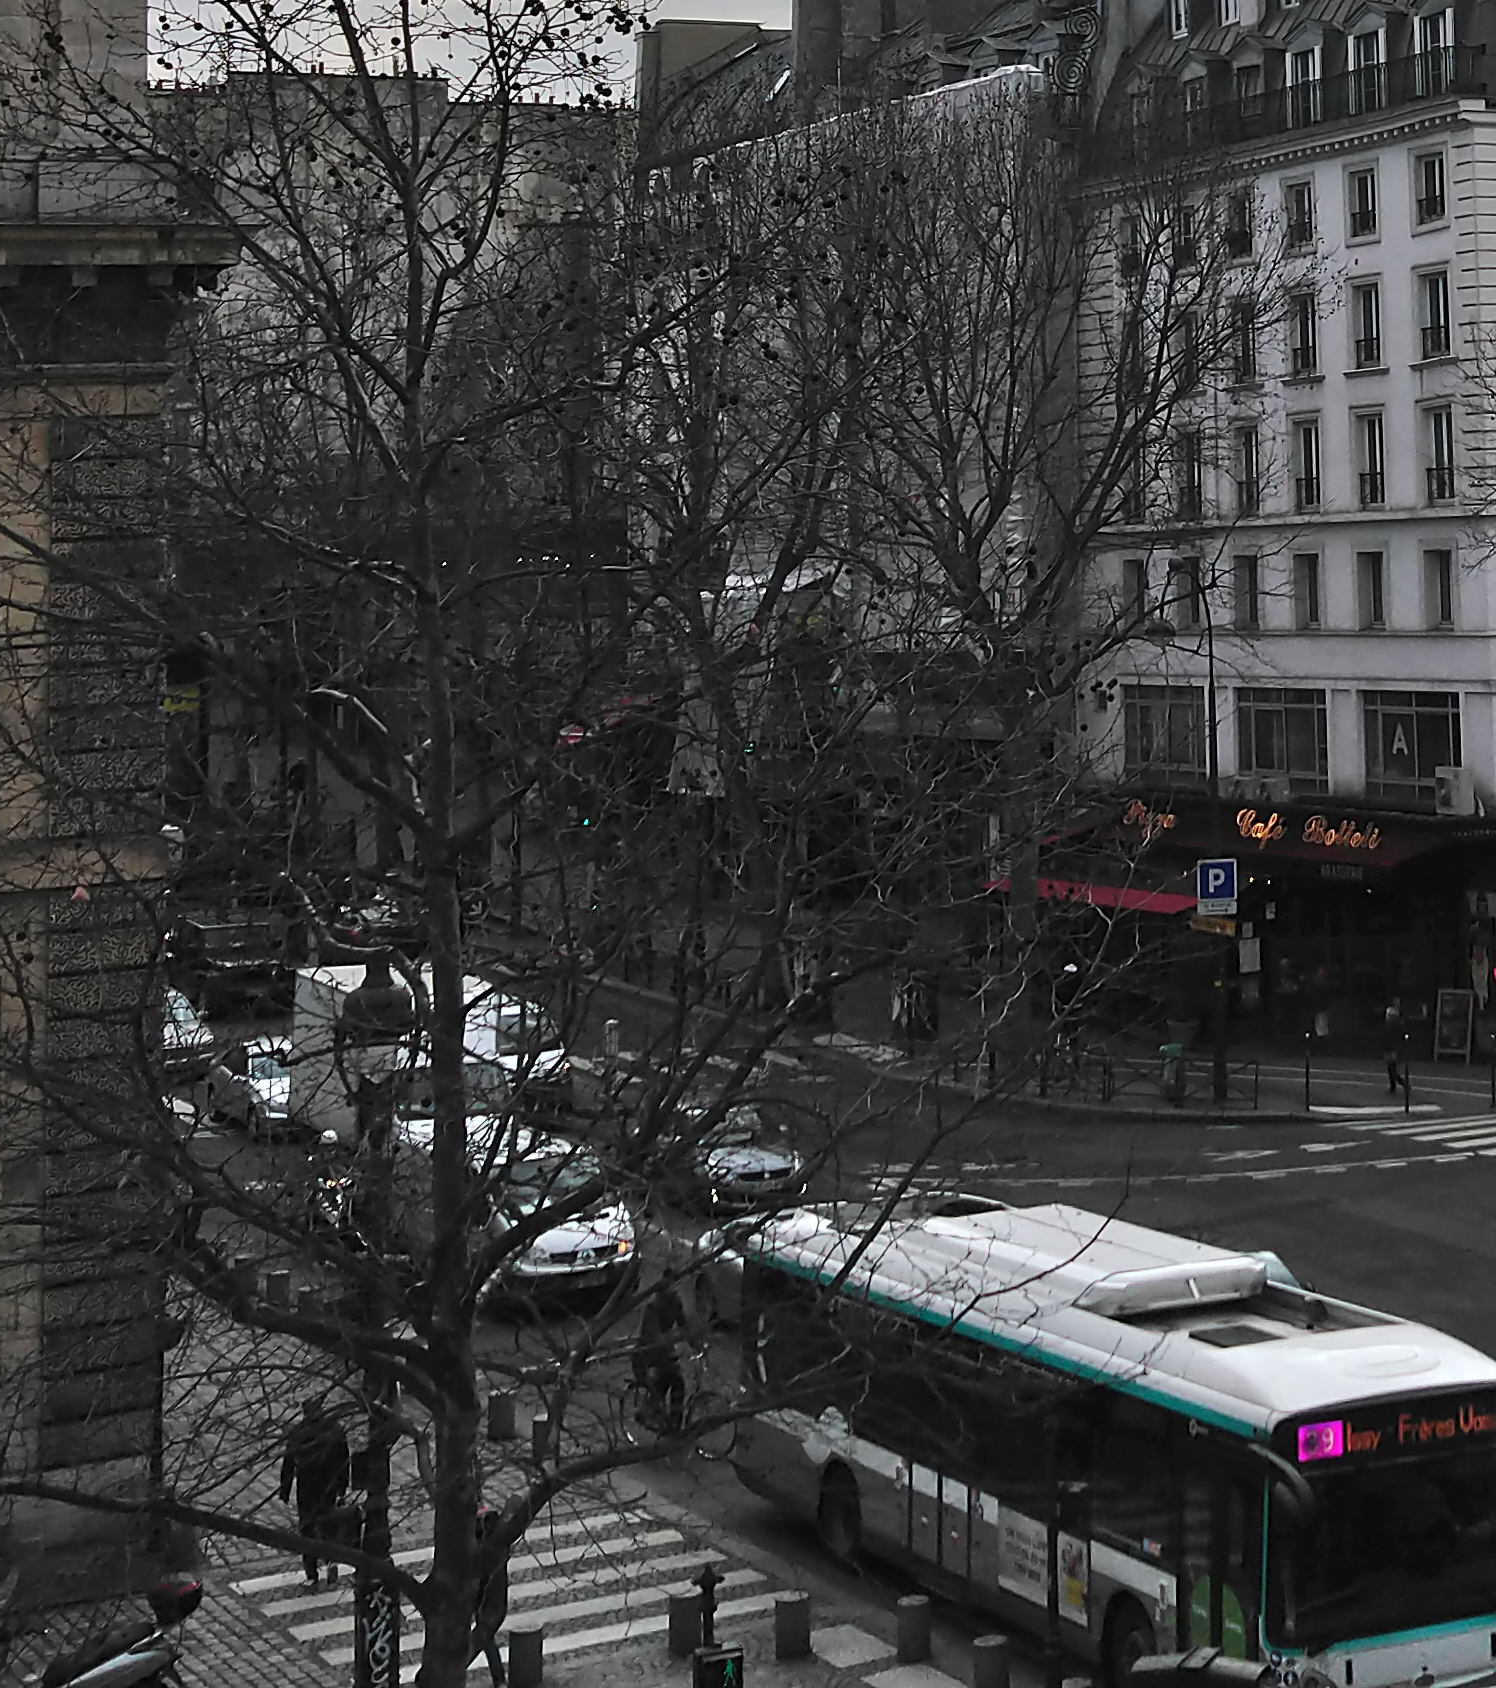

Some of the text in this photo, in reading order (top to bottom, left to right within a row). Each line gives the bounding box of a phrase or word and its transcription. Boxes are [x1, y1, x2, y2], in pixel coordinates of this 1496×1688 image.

[1392, 722, 1409, 756] A
[1234, 806, 1289, 850] Café
[1209, 868, 1226, 894] P
